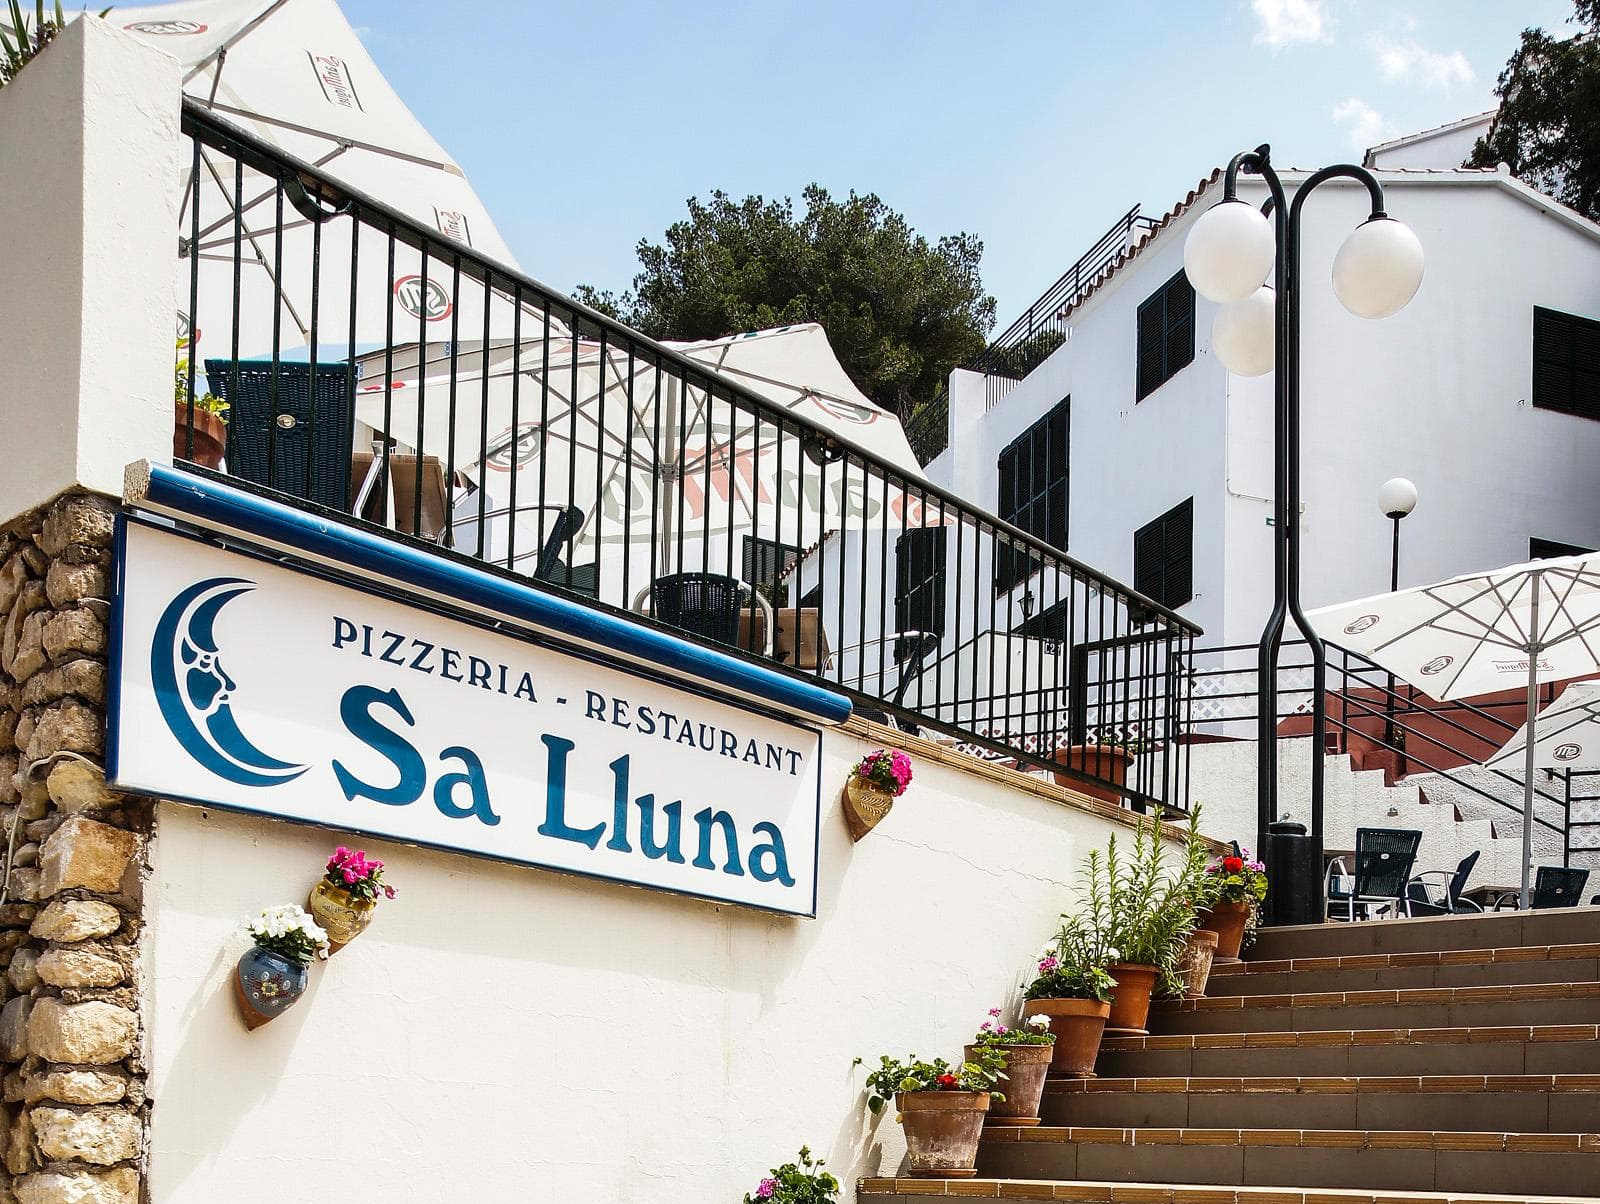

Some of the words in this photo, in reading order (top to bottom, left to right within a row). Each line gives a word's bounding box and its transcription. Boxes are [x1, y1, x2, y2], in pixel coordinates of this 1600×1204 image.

[332, 616, 538, 703] PIZZERIA
[585, 689, 803, 775] RESTAURANT
[332, 685, 500, 826] Sa
[538, 734, 795, 887] Lluna
